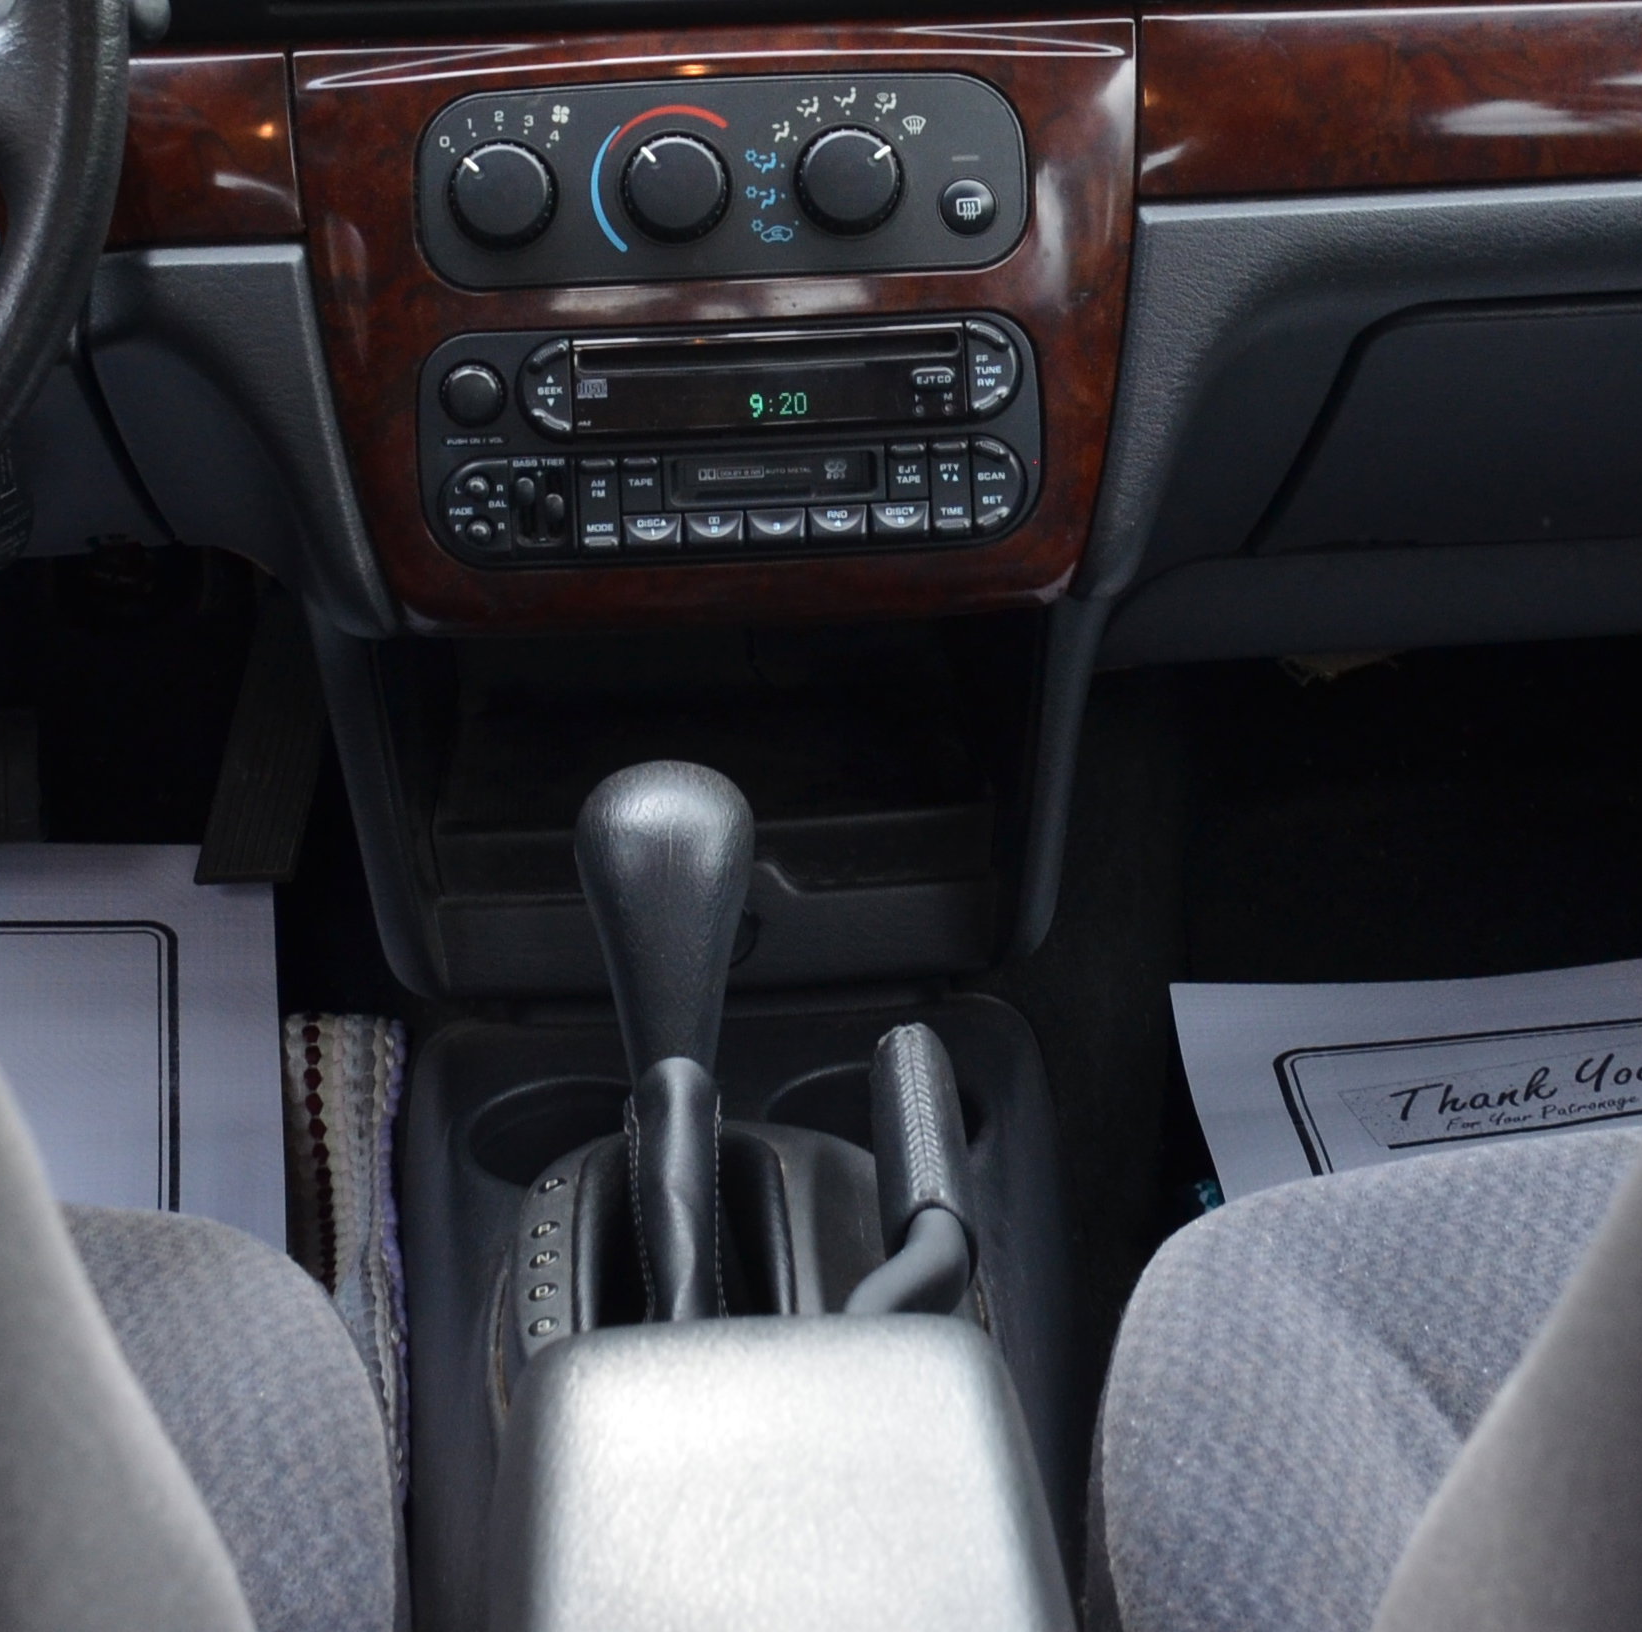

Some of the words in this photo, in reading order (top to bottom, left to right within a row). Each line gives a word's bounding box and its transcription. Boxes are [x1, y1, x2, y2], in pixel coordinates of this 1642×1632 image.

[494, 110, 504, 123] 2
[523, 115, 534, 127] 3
[467, 118, 472, 130] 1
[549, 130, 560, 142] 4
[439, 136, 450, 147] 0
[975, 355, 988, 363] FF
[975, 366, 1002, 375] TUNE
[917, 376, 935, 384] EJT
[937, 375, 952, 384] CD
[977, 378, 996, 387] RW
[537, 386, 563, 395] SEEK
[749, 393, 808, 417] 9:20
[512, 459, 538, 467] BASS
[541, 458, 565, 466] TREB
[898, 465, 917, 474] EJT
[940, 464, 959, 472] PTY
[896, 475, 921, 484] TAPE
[977, 472, 1005, 481] SCAN
[590, 480, 606, 488] AM
[628, 478, 654, 487] TAPE
[591, 489, 606, 498] FM
[488, 500, 507, 508] BAL
[982, 495, 1002, 504] SET
[449, 507, 473, 516] FADE
[827, 510, 848, 519] RND
[886, 507, 909, 516] DISC
[940, 507, 964, 516] TIME
[586, 523, 614, 533] MODE
[637, 519, 660, 528] DISC
[773, 522, 780, 531] 3
[1389, 1065, 1558, 1122] Thank
[1446, 1116, 1482, 1131] For
[1489, 1113, 1532, 1127] Your
[1541, 1095, 1640, 1120] Patronage
[545, 1179, 558, 1190] P
[536, 1252, 550, 1264] N
[535, 1285, 549, 1298] D
